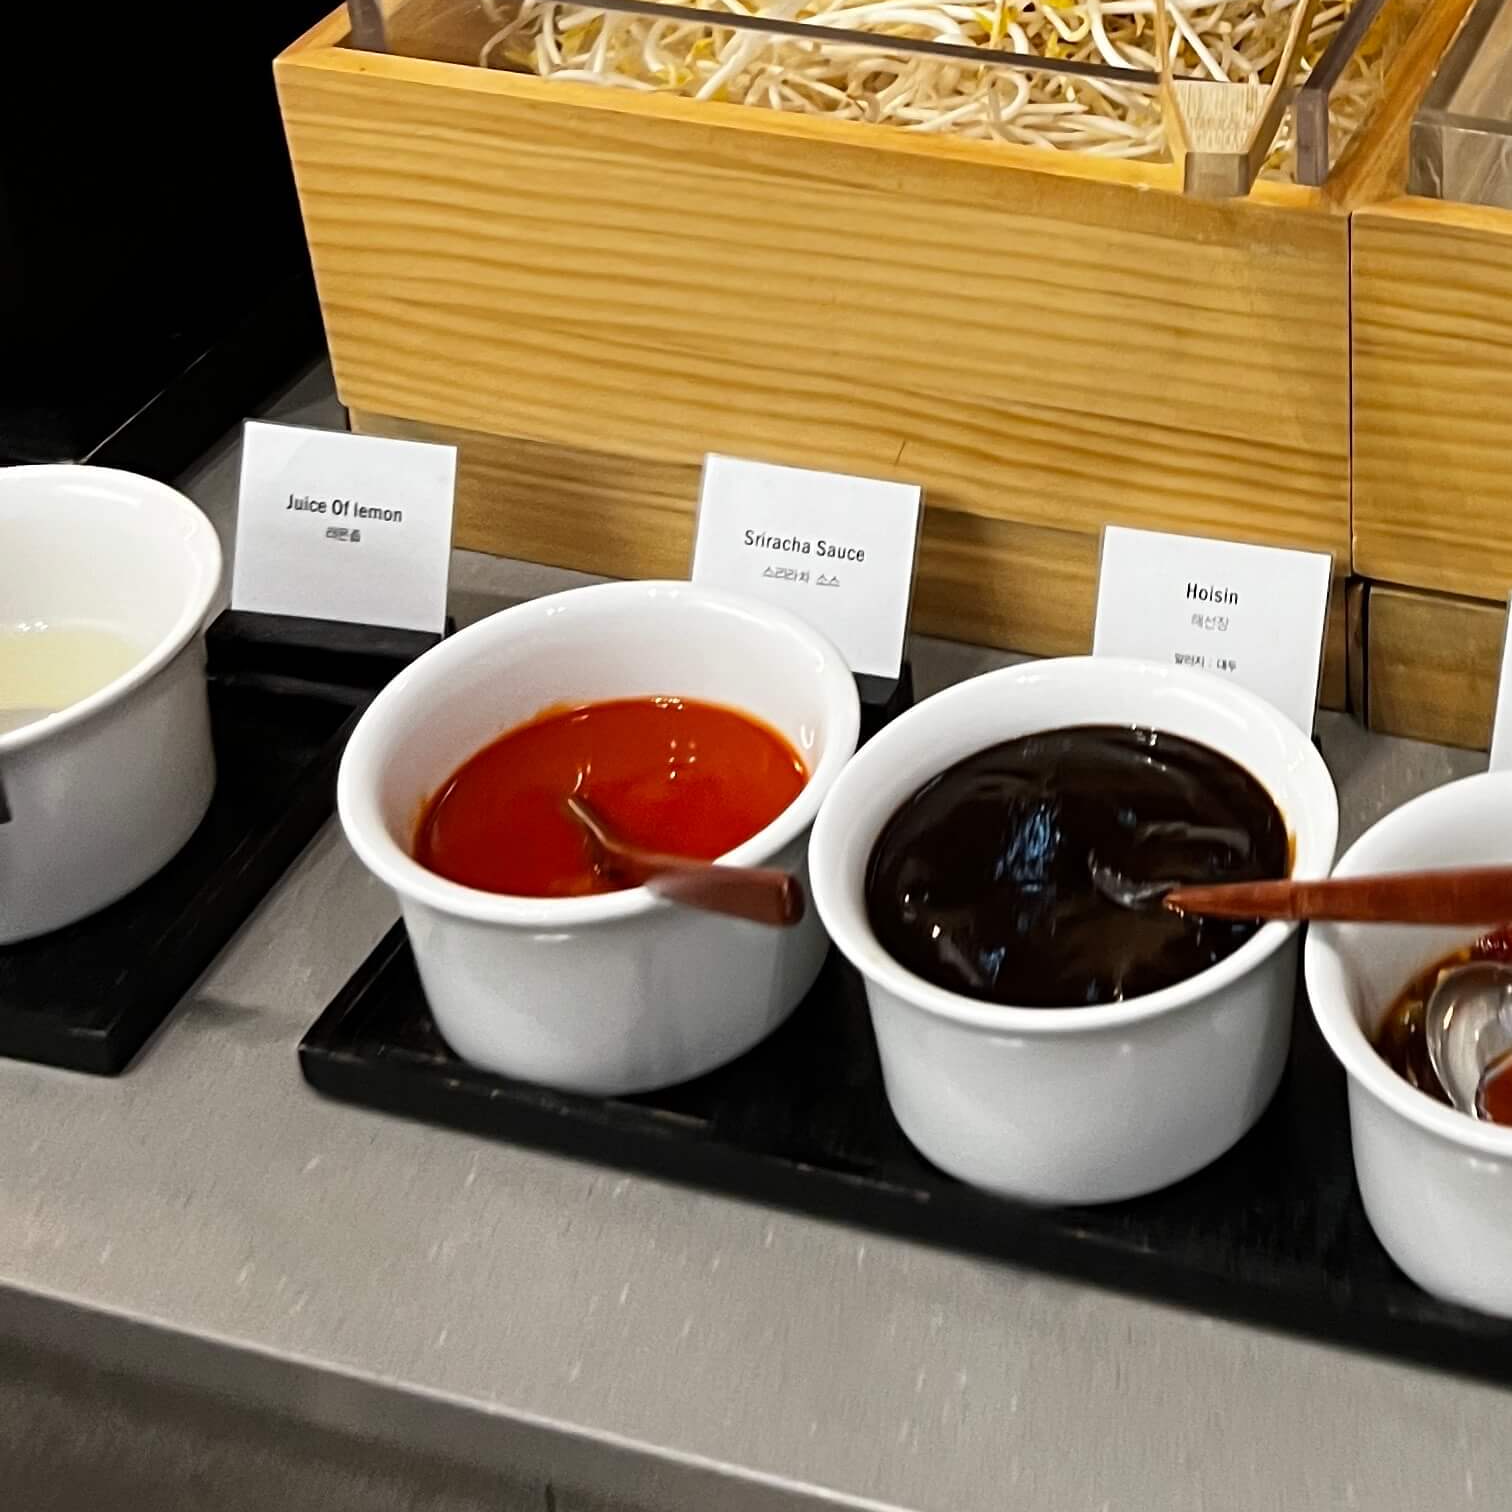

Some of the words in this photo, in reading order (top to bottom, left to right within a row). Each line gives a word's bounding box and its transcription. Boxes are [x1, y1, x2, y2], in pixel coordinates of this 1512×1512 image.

[286, 493, 327, 514] Juice
[331, 499, 350, 516] Of
[353, 502, 402, 523] lemon
[744, 529, 811, 555] Sriracha
[816, 540, 865, 563] Sauce
[815, 573, 841, 588] 소스
[1186, 582, 1239, 605] Hoisin
